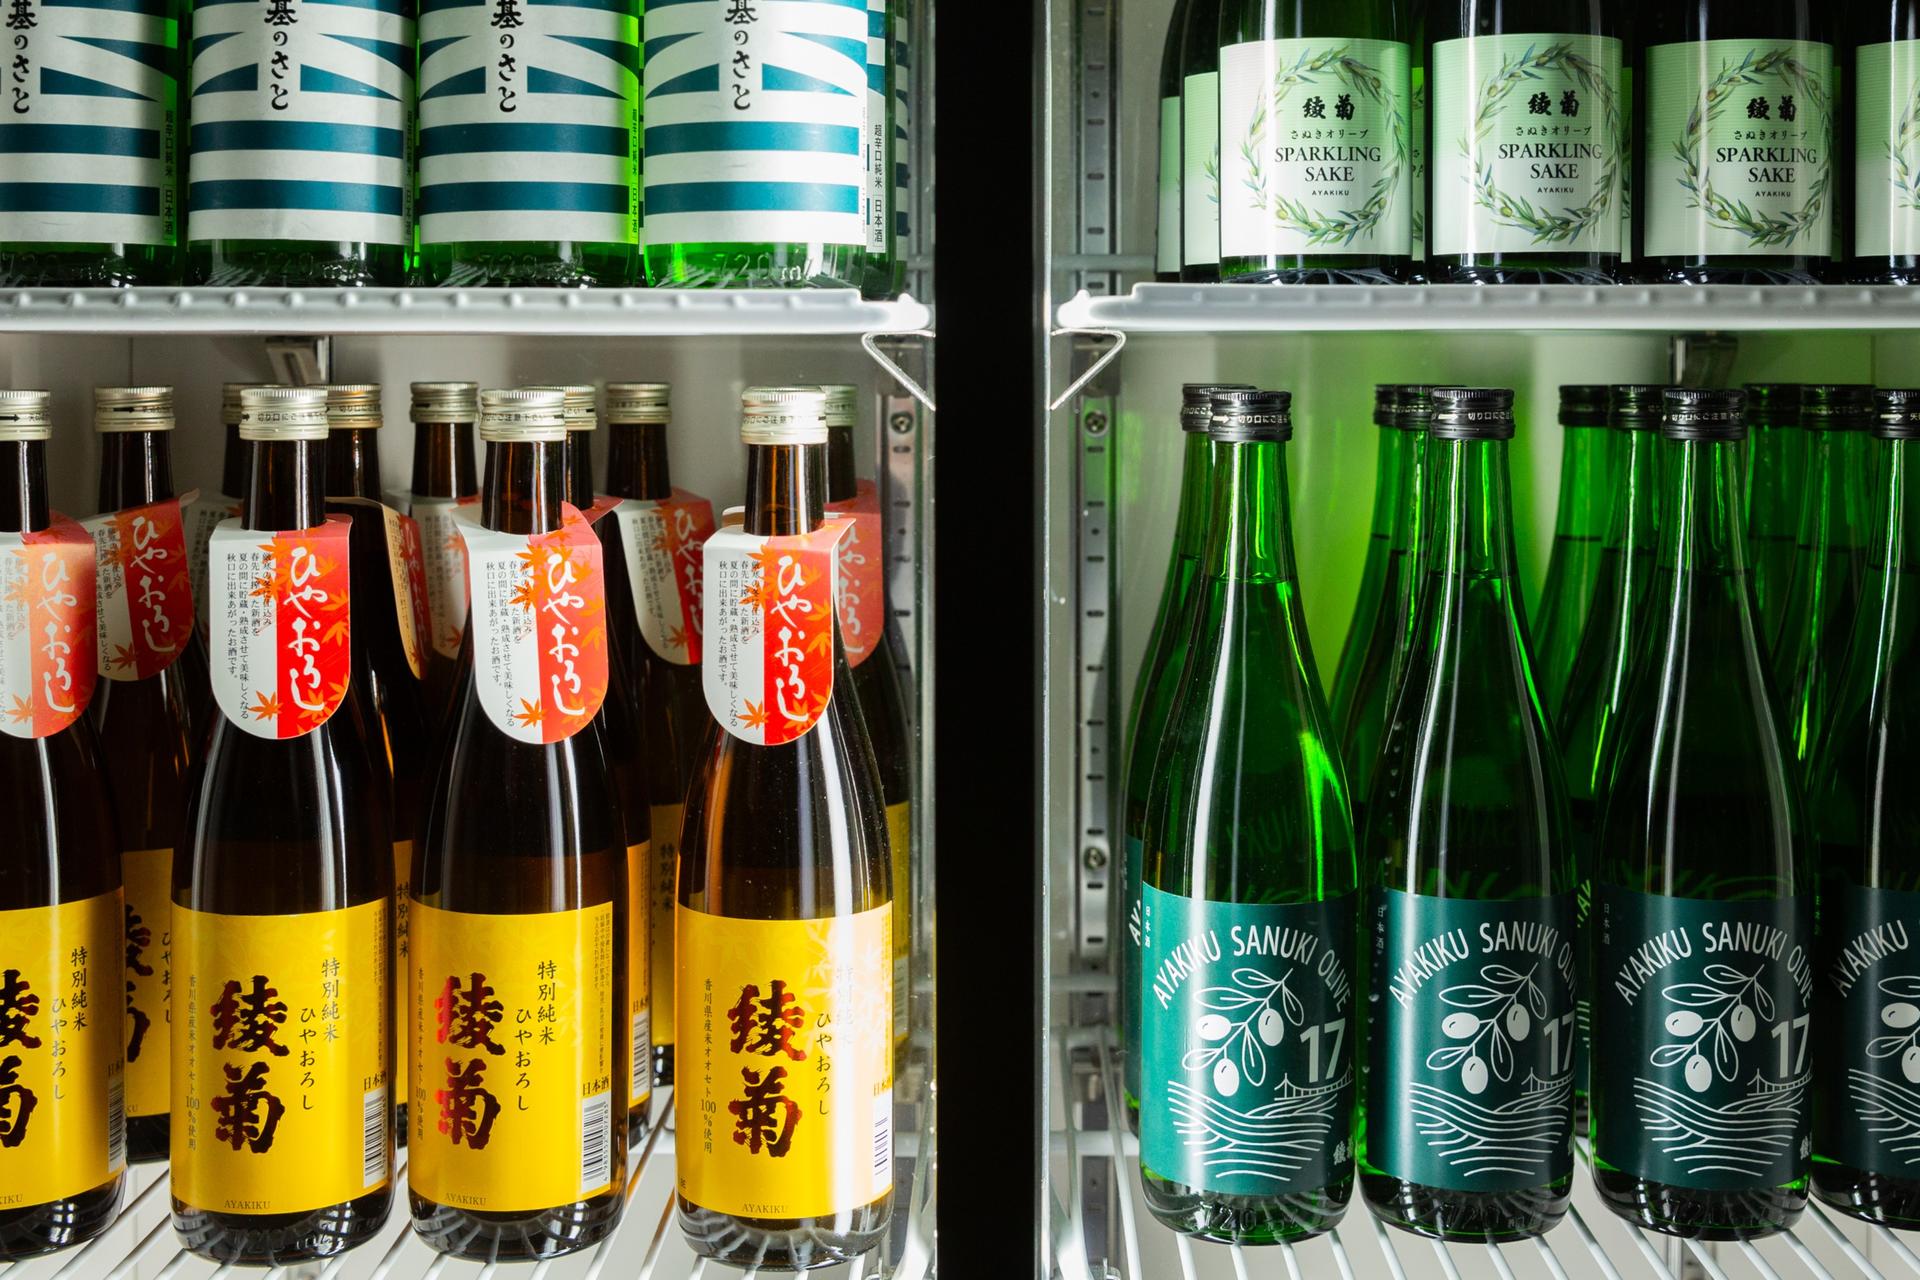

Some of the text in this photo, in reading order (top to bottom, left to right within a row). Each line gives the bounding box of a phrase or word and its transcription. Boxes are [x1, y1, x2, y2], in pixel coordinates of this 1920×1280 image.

[875, 124, 883, 189] 超辛口純米
[1275, 146, 1381, 163] SPARKLING
[1290, 129, 1368, 140] さぬきオリーブ
[1498, 143, 1602, 159] SPARKLING
[1516, 126, 1592, 136] さぬきオリーブ
[1716, 147, 1817, 164] SPARKLING
[1734, 130, 1807, 140] さぬきオリーブ
[1305, 166, 1354, 182] SAKE
[1530, 163, 1580, 179] SAKE
[1748, 167, 1796, 183] SAKE
[875, 199, 883, 243] 日本酒
[130, 516, 176, 651] ひやおろし
[37, 553, 77, 713] ひやおろし
[284, 547, 328, 711] ひやおろし
[542, 554, 585, 716] ひやおろし
[770, 555, 812, 722] ひやおろし
[72, 945, 88, 1032] 特別純米
[1153, 925, 1351, 1013] AYAKIKU SANUKI OLIVE
[1389, 928, 1470, 1010] AYAKIKU
[1479, 921, 1559, 959] SANUKI
[1614, 926, 1692, 1007] AYAKIKU
[1702, 921, 1788, 961] SANUKI
[1828, 919, 1909, 998] AYAKIKU
[321, 958, 340, 1043] 特別純米
[537, 959, 557, 1046] 特別純米
[51, 997, 66, 1100] ひやおろし
[210, 975, 290, 1154] 綾菊
[300, 1006, 316, 1111] ひやおろし
[434, 972, 506, 1150] 綾菊
[515, 1007, 532, 1112] ひやおろし
[727, 979, 807, 1158] 綾菊
[815, 1013, 832, 1116] ひやおろし
[1300, 1018, 1347, 1083] 17
[1543, 1012, 1575, 1076] 17
[1770, 1012, 1811, 1079] 17
[583, 1075, 610, 1096] 日本酒
[224, 1199, 271, 1210] AYAKIKU
[444, 1192, 487, 1207] AYAKIKU
[741, 1202, 789, 1215] AYAKIKU
